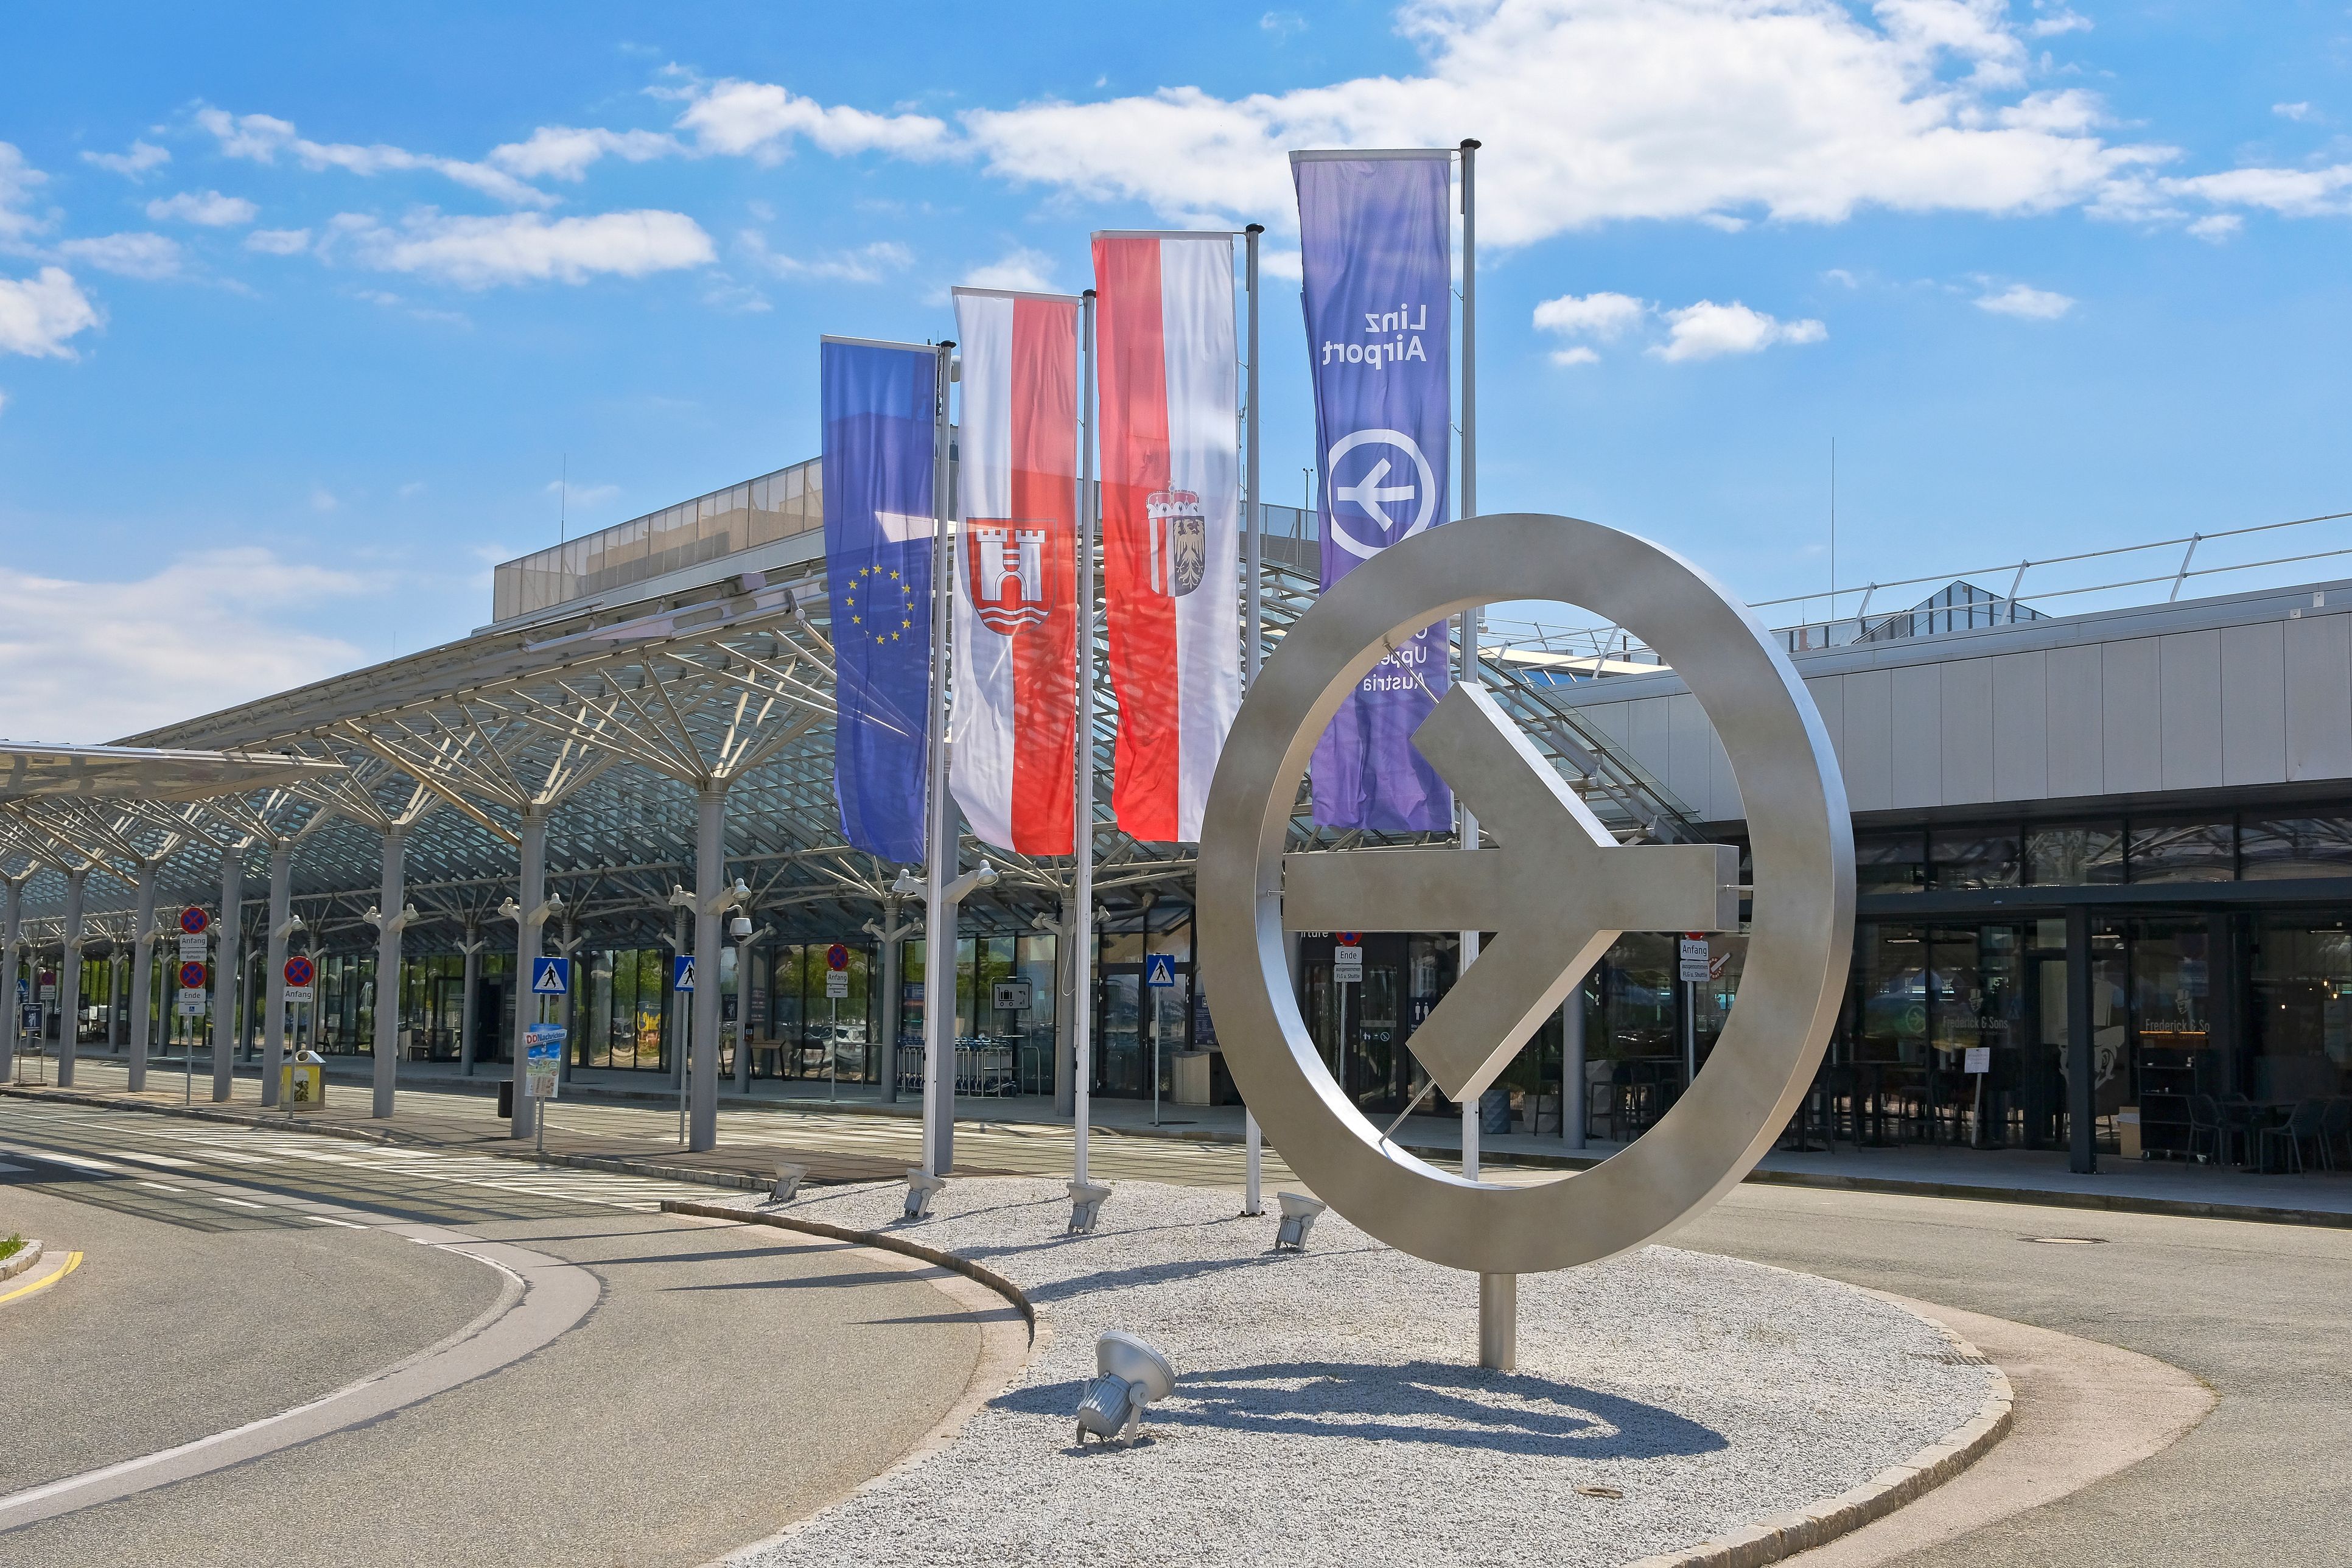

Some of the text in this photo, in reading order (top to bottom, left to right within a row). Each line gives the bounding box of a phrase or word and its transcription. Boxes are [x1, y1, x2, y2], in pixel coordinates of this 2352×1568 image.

[1340, 951, 1357, 959] Ende
[1682, 945, 1707, 957] Anfang
[285, 990, 312, 999] Anfang
[1943, 1015, 2009, 1029] Frederick & Sons
[2146, 1018, 2187, 1031] Frederick
[2199, 1019, 2210, 1032] So
